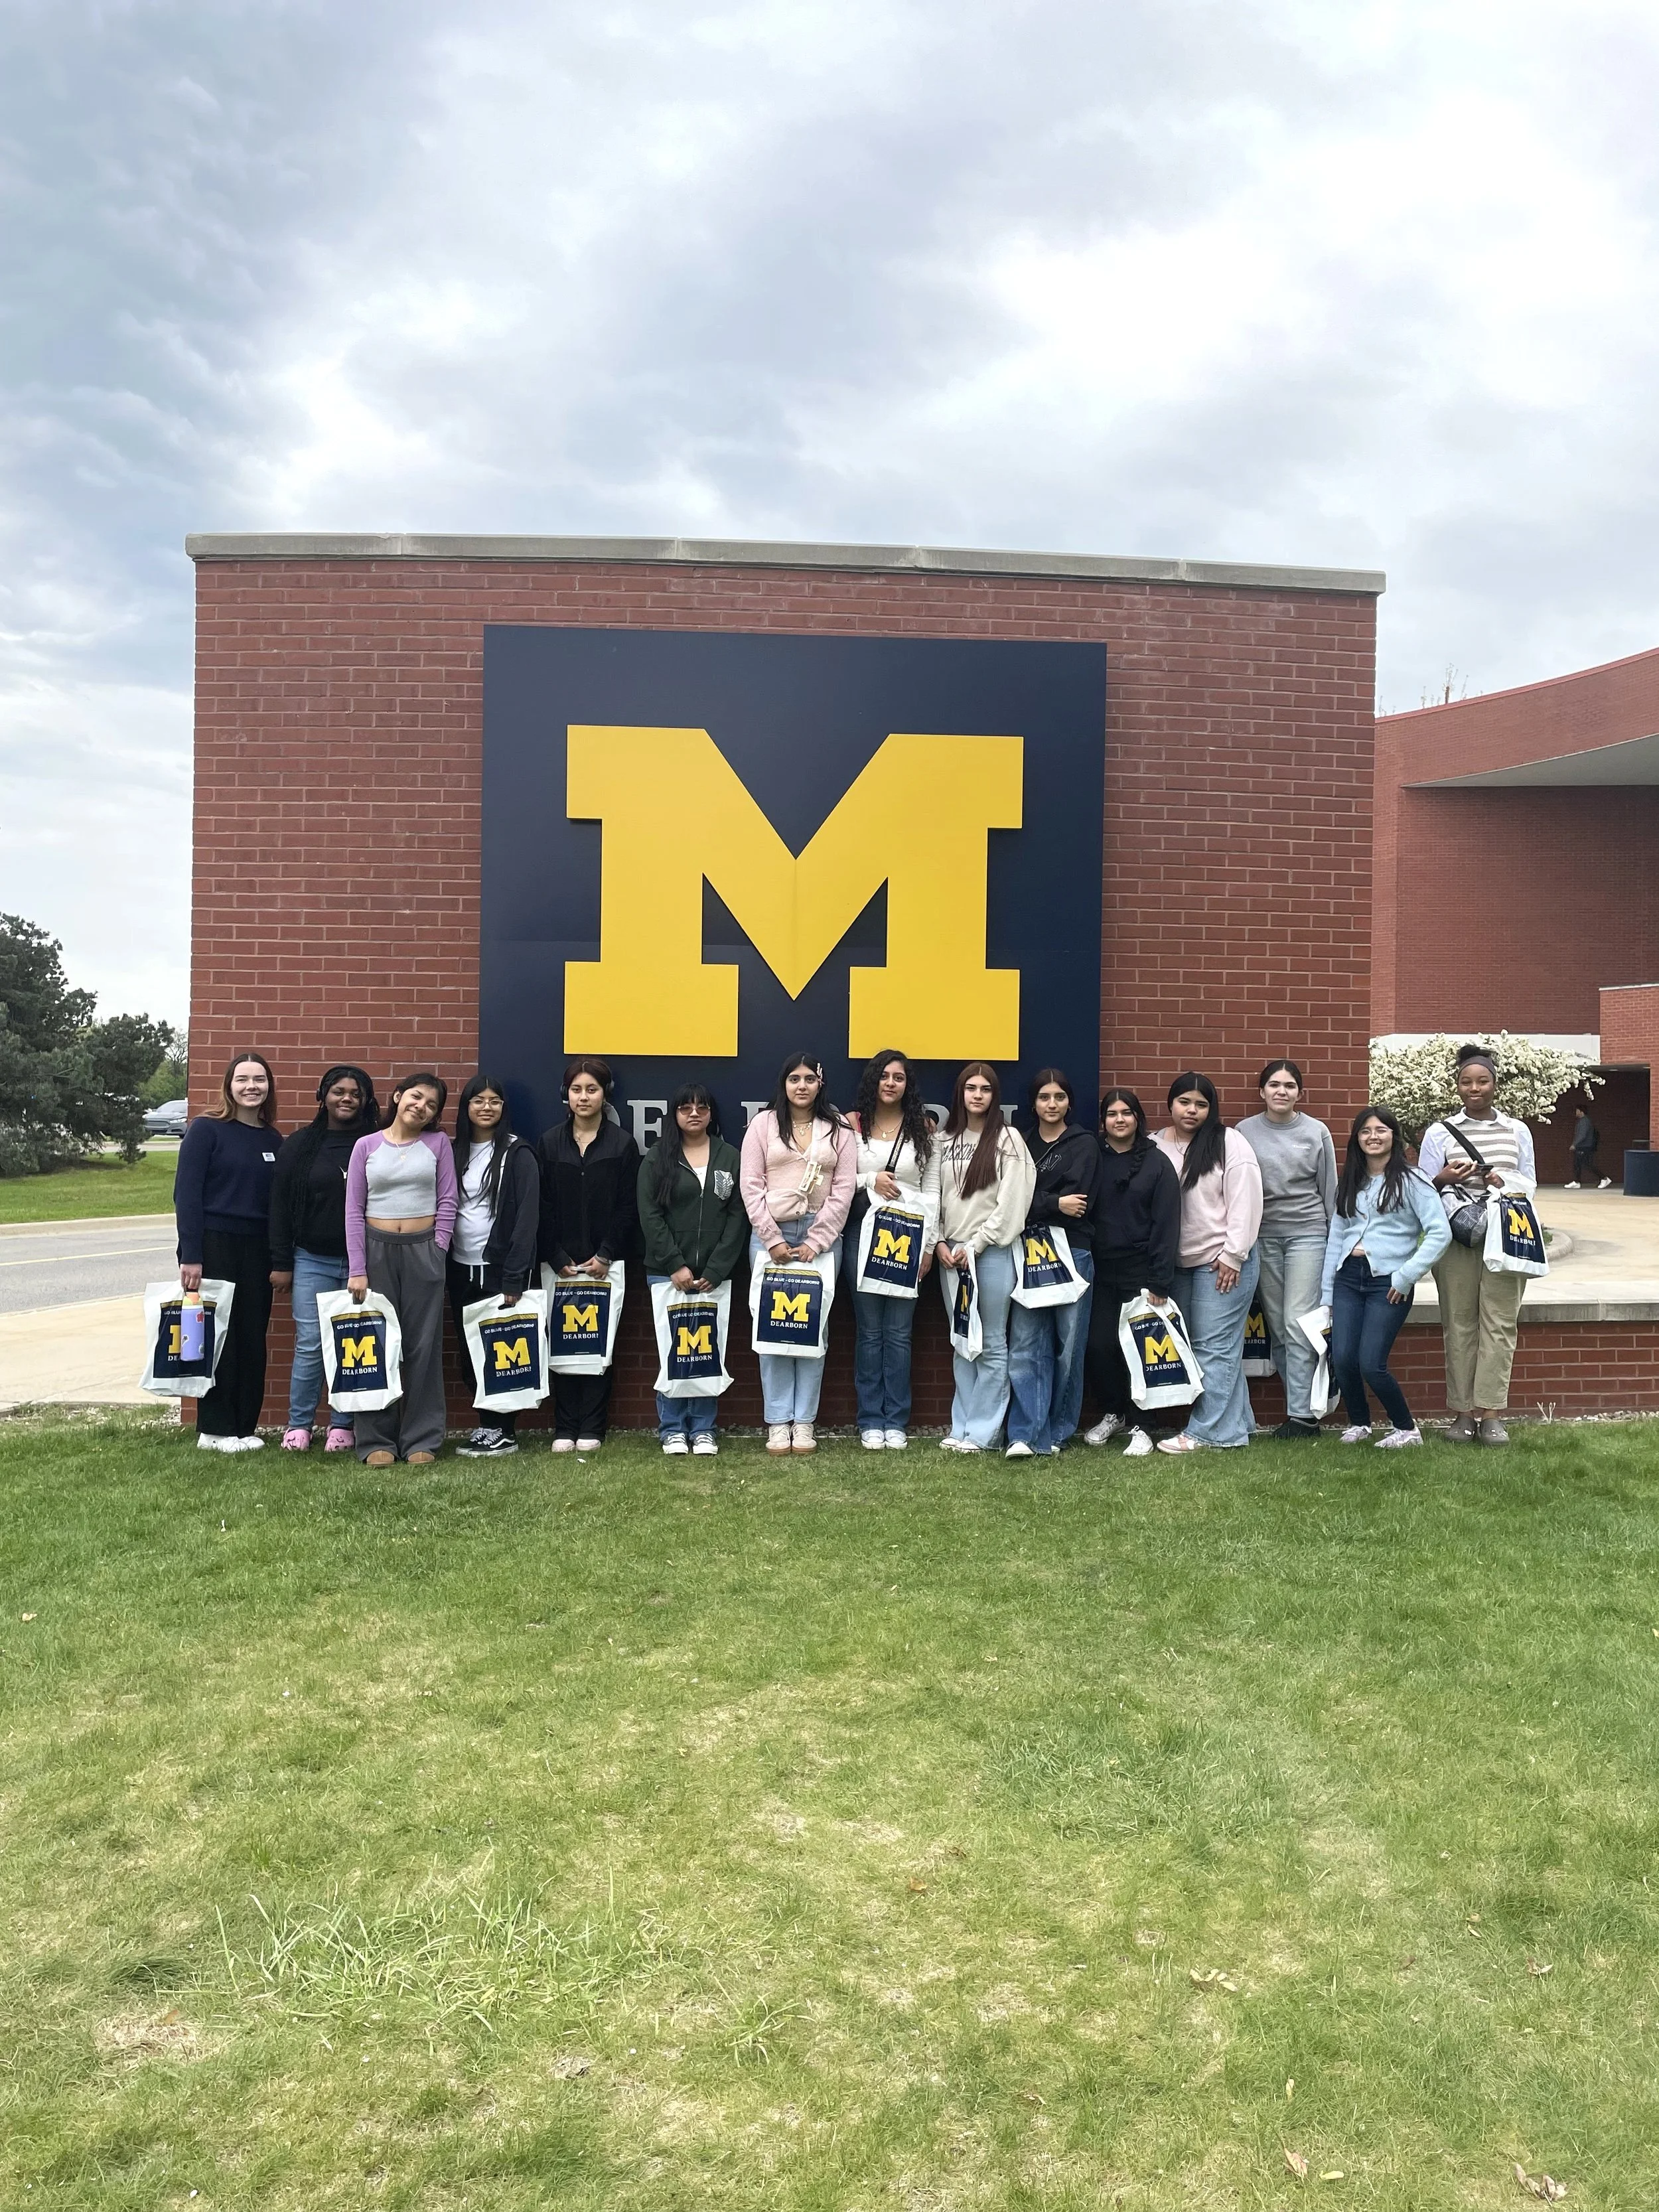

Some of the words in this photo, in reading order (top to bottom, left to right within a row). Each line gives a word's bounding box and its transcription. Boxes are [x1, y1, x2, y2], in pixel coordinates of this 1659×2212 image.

[564, 725, 1024, 1061] M
[1508, 1208, 1534, 1239] M
[873, 1228, 911, 1264] M
[1025, 1238, 1058, 1266] M
[871, 1256, 908, 1270] DEARBORN
[563, 1304, 599, 1333] M
[771, 1291, 811, 1322] M
[770, 1320, 808, 1329] DEARBORN
[1245, 1312, 1266, 1338] M
[342, 1335, 378, 1368] M
[493, 1337, 531, 1370] M
[677, 1325, 712, 1355] M
[1145, 1334, 1180, 1364] M
[342, 1367, 378, 1376] DEARBORN
